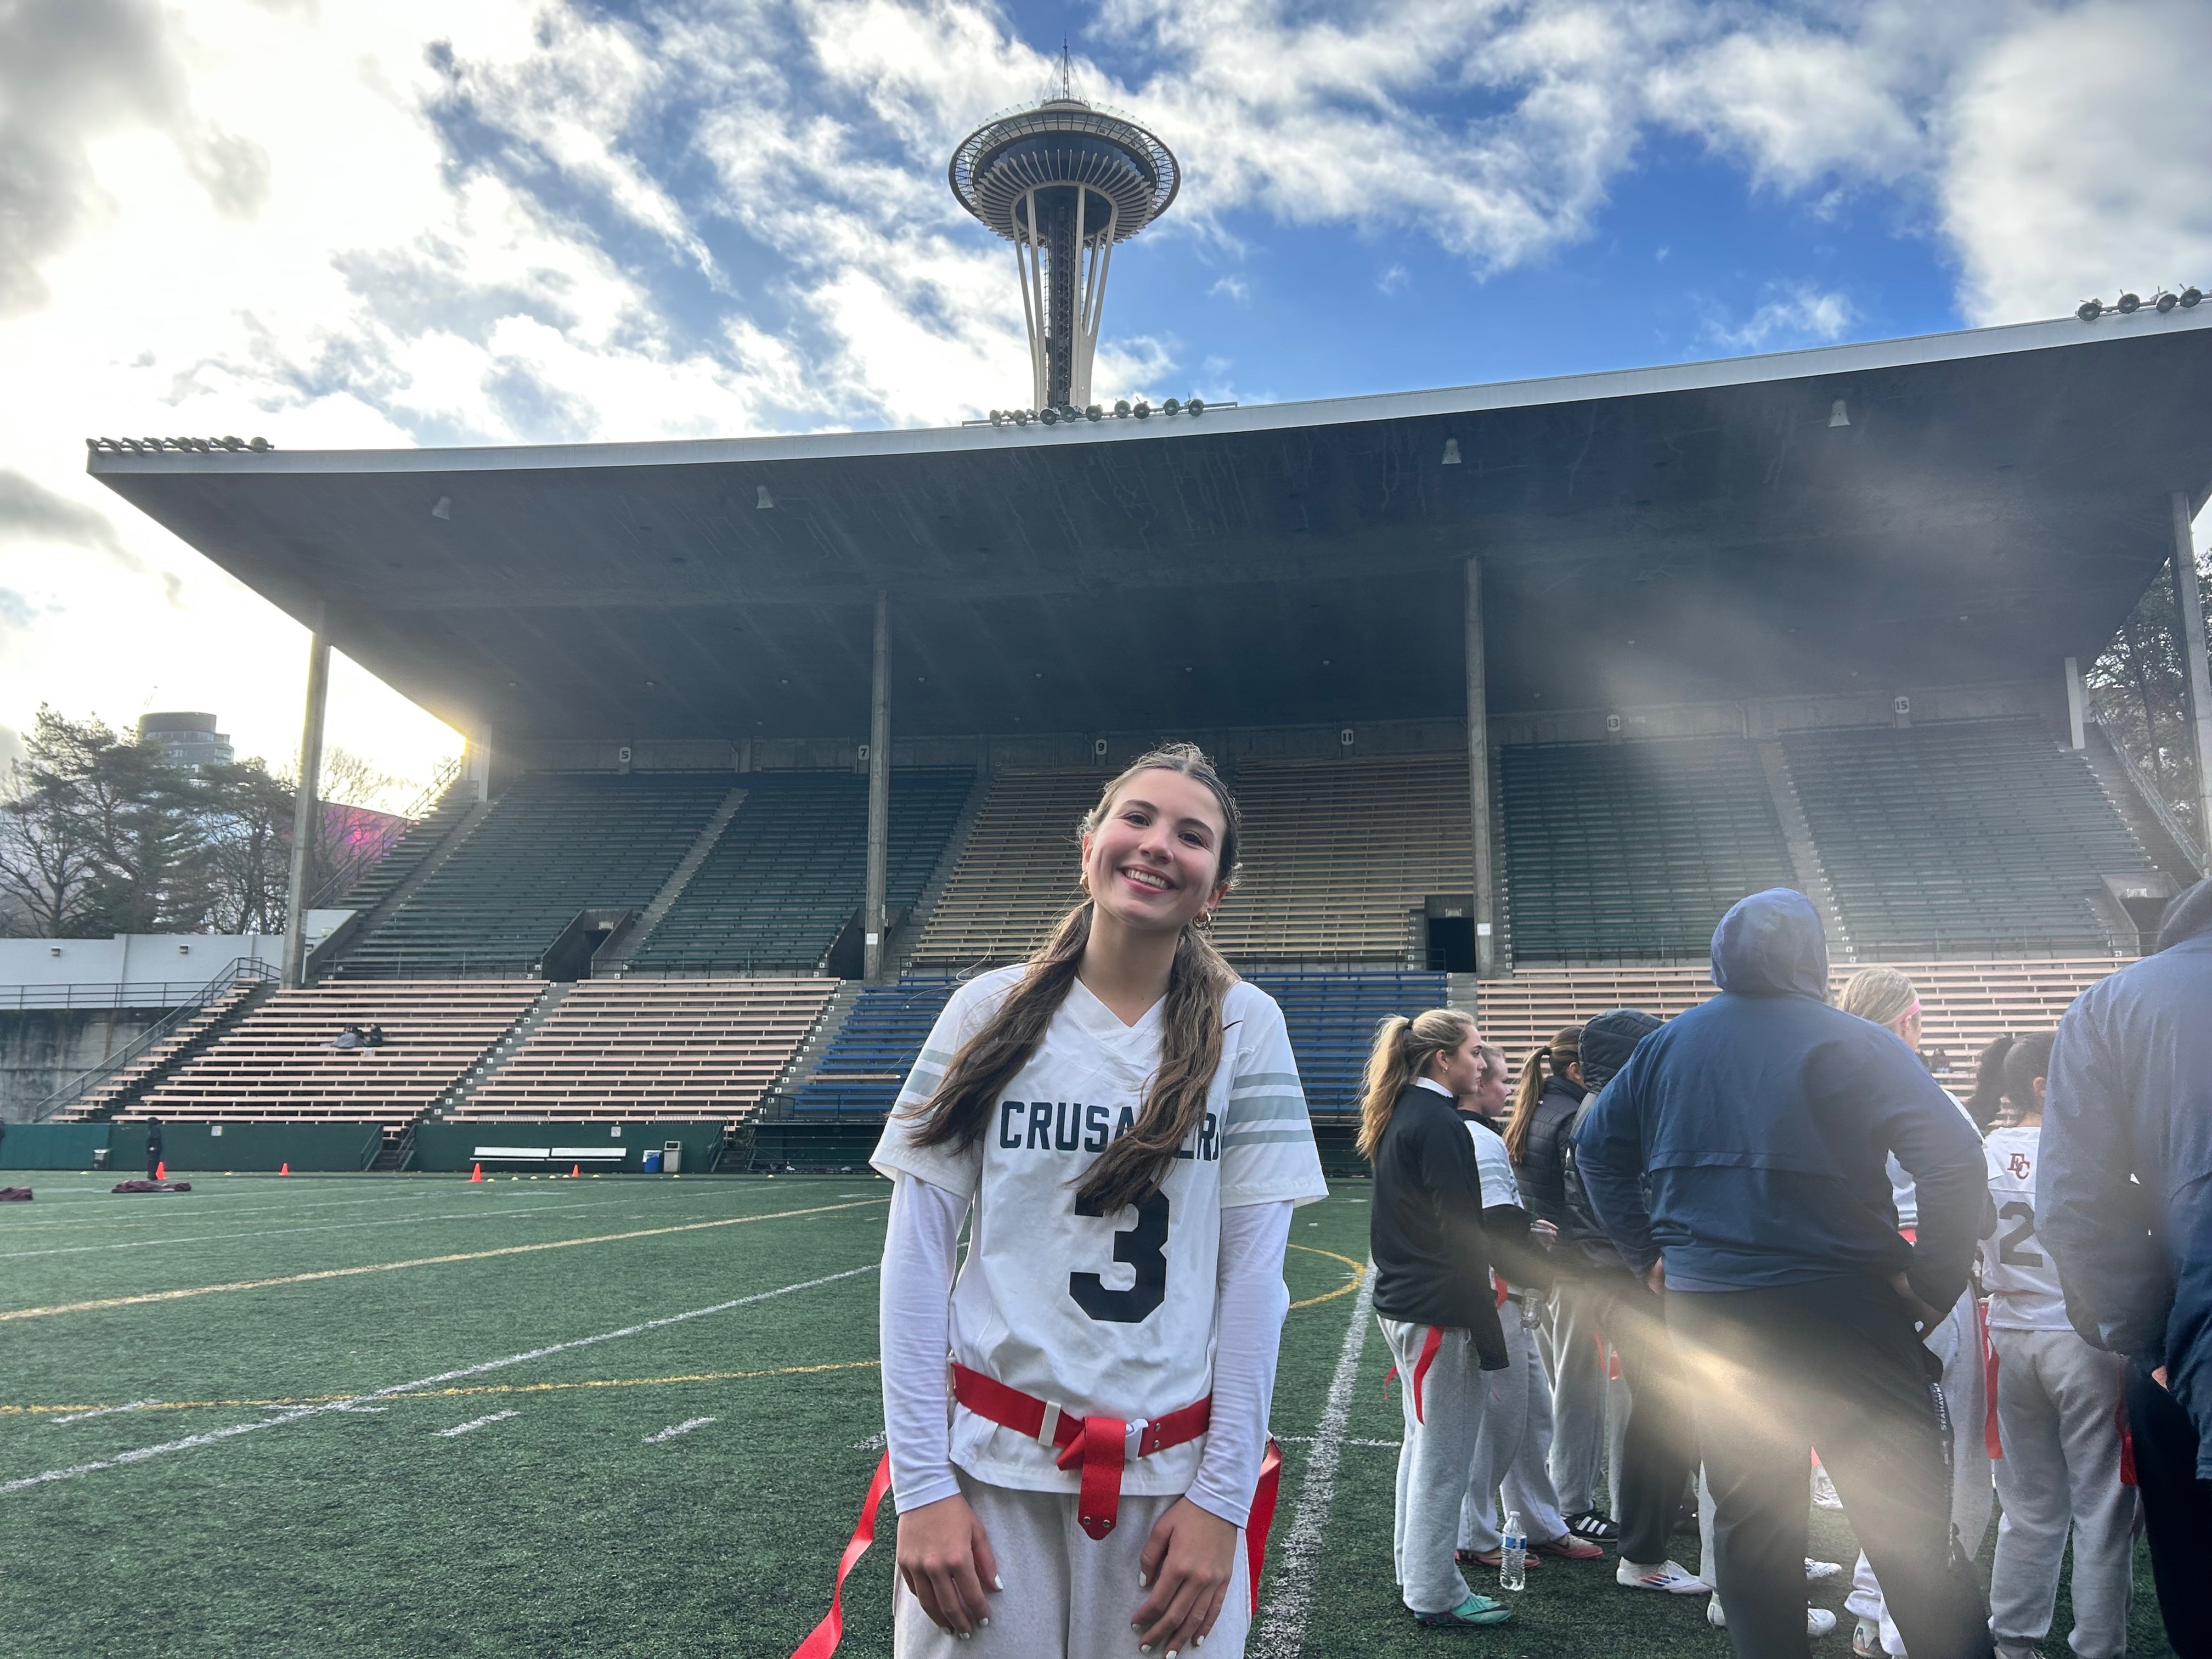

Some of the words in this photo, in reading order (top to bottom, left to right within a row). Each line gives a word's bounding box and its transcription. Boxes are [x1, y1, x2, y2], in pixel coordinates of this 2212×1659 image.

[1895, 701, 1908, 710] 15
[1608, 718, 1618, 728] 13
[1342, 733, 1352, 742] 11
[1098, 742, 1105, 751] 9
[622, 751, 629, 759] 5
[861, 748, 867, 757] 7
[1000, 1101, 1219, 1161] CRUSAR
[1999, 1201, 2042, 1268] 2
[1069, 1181, 1170, 1323] 3
